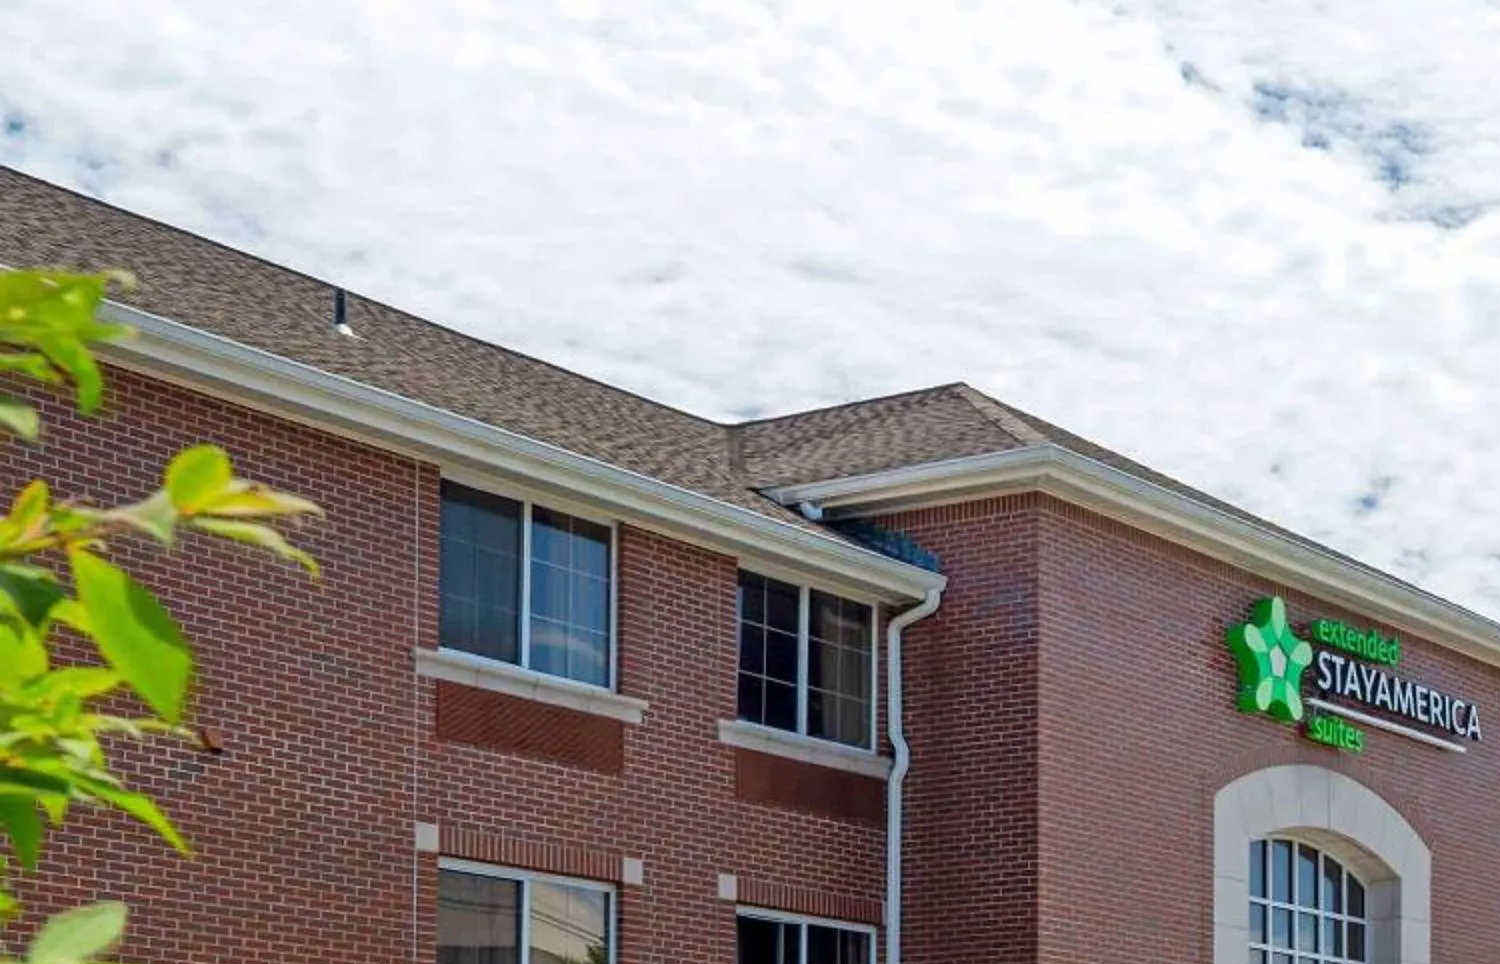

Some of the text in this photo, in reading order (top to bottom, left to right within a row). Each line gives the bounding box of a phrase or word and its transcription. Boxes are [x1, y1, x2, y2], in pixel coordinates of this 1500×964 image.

[1320, 618, 1400, 666] extended
[1318, 651, 1483, 742] STAYAMERICA
[1315, 717, 1364, 752] suites
